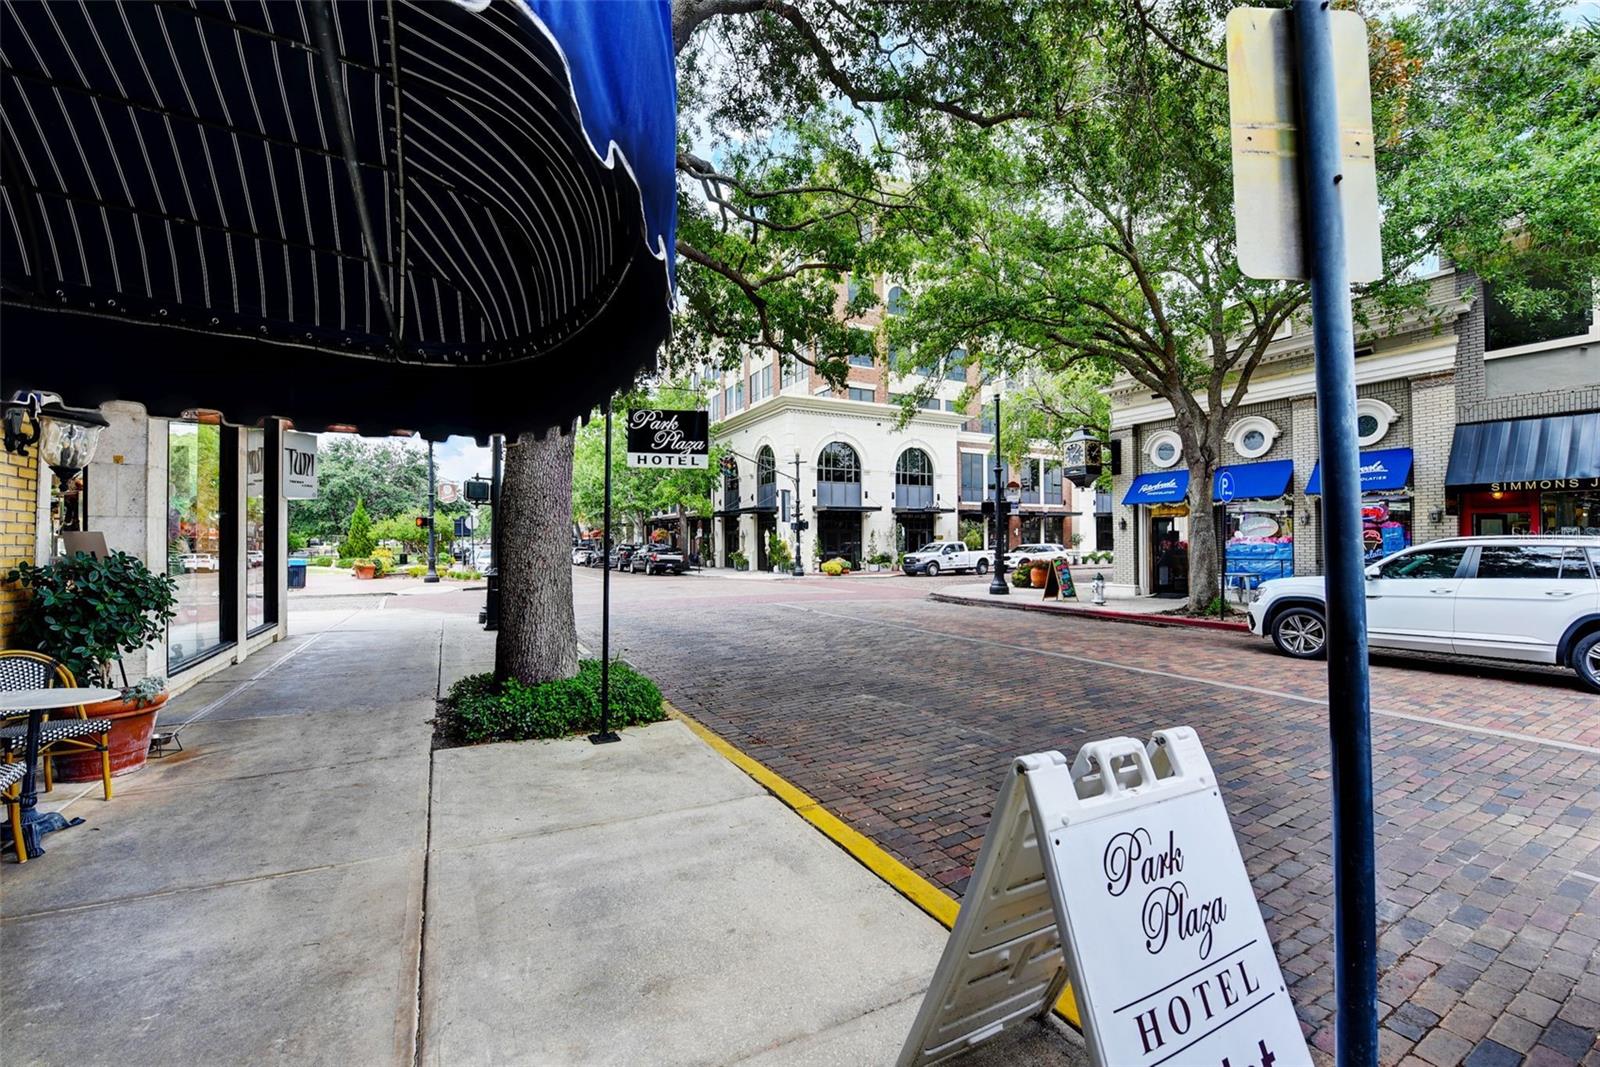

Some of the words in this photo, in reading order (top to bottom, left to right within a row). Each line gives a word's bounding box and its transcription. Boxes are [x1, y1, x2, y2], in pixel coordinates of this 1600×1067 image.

[630, 409, 679, 430] Park
[651, 429, 706, 455] Plaza
[637, 455, 700, 466] HOTEL
[1491, 479, 1580, 492] SIMMONS
[1103, 827, 1184, 897] Park
[1141, 881, 1227, 960] Plaza
[1133, 960, 1261, 1056] HOTEL
